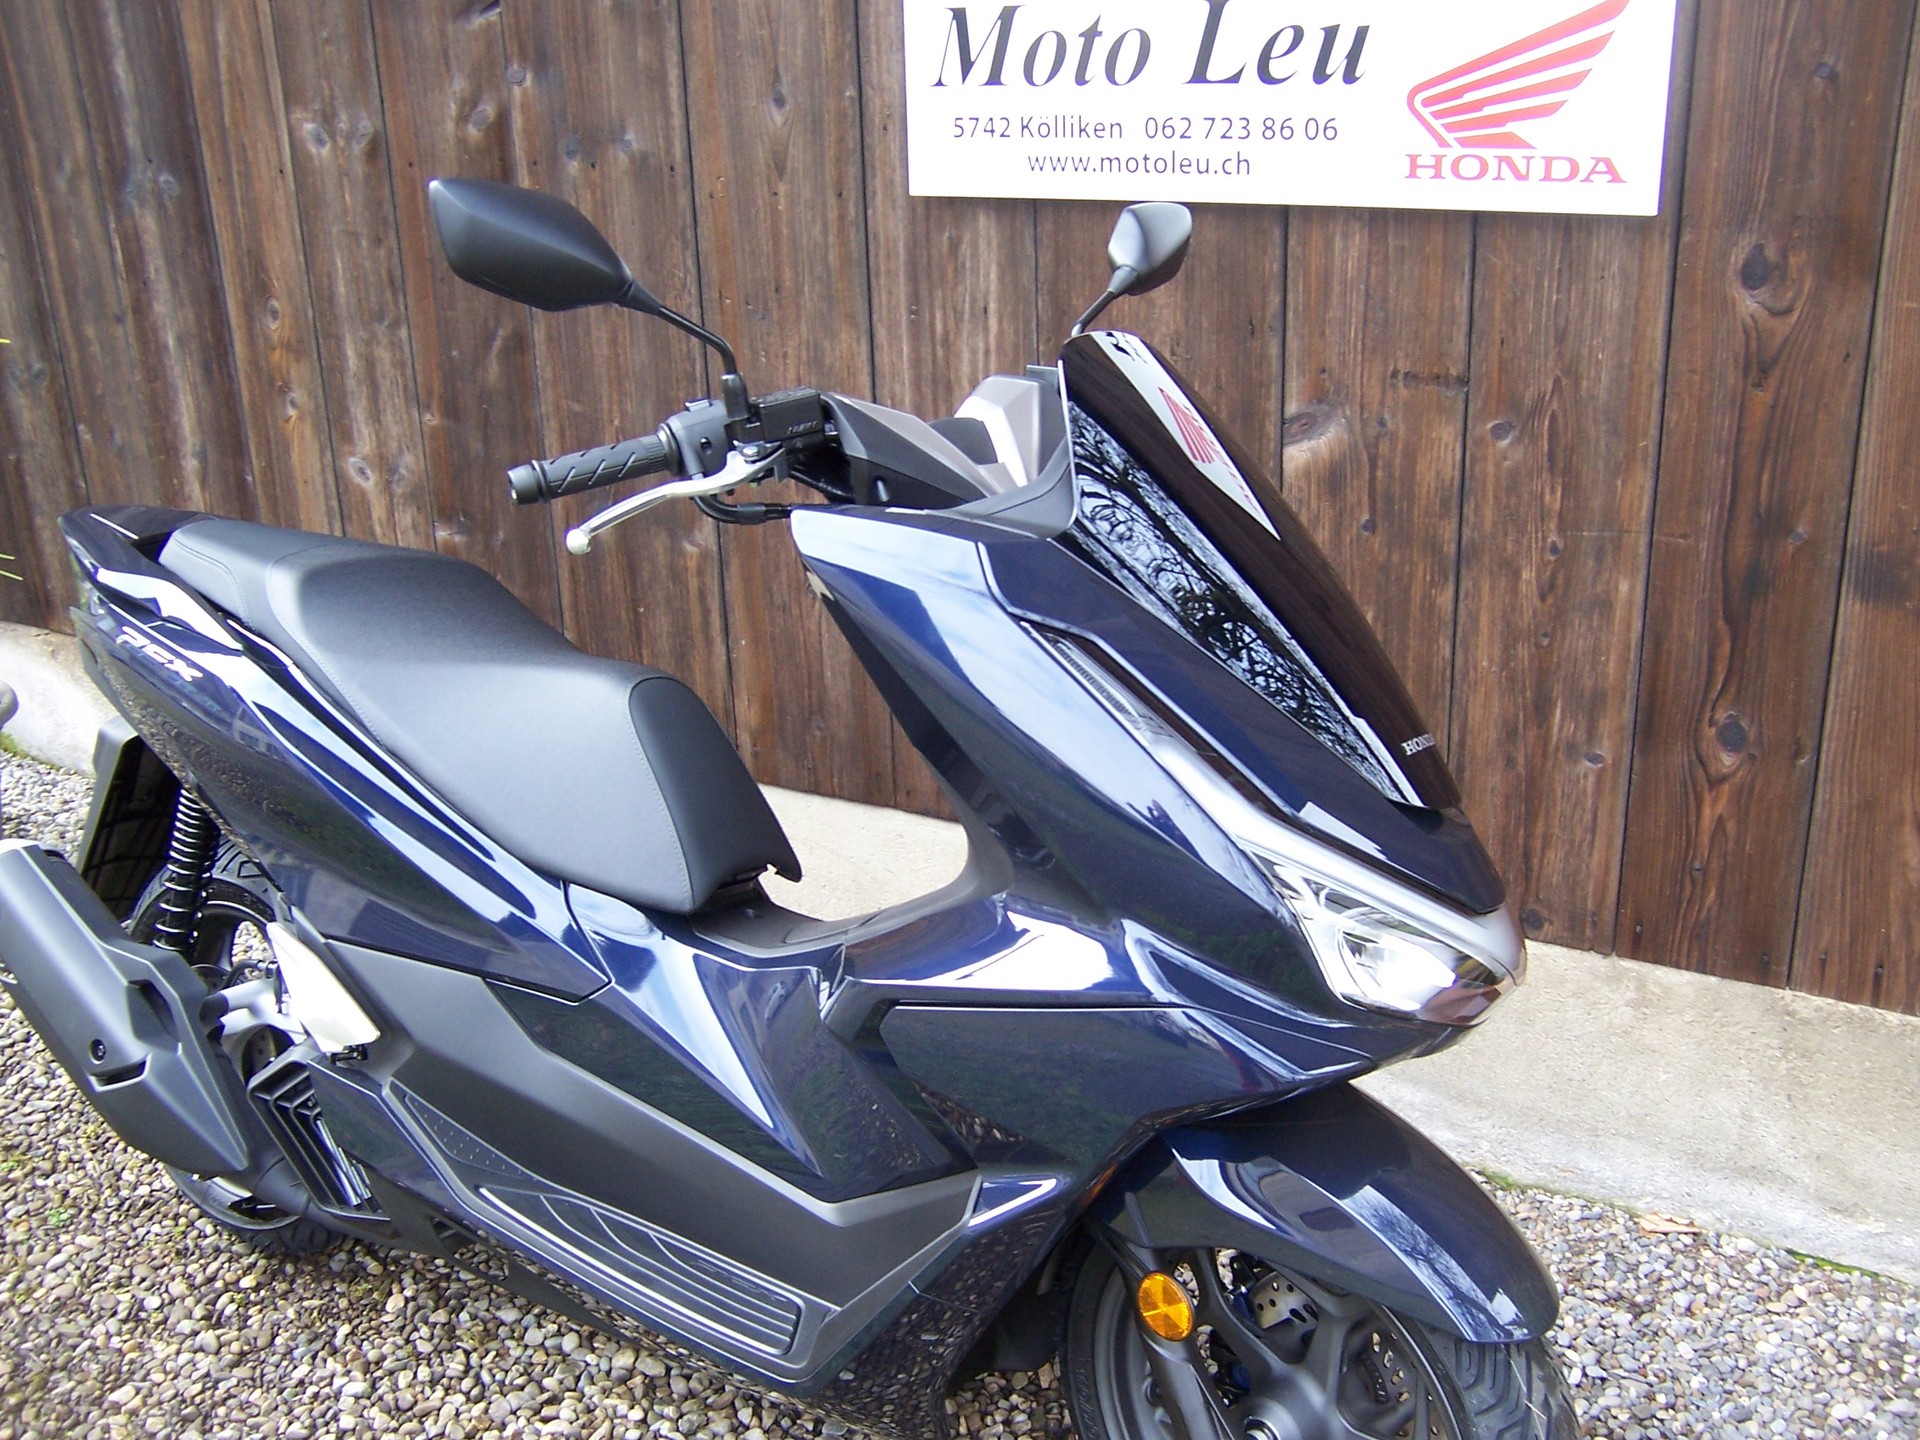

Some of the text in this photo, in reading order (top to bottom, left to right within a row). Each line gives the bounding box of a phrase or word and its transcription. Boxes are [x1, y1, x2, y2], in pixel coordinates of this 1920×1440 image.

[930, 0, 1370, 87] Moto Leu
[953, 114, 1338, 141] 5742 Kölliken 062 723 86 06
[1027, 149, 1251, 176] www.motoleu.ch
[1403, 153, 1628, 184] HONDA
